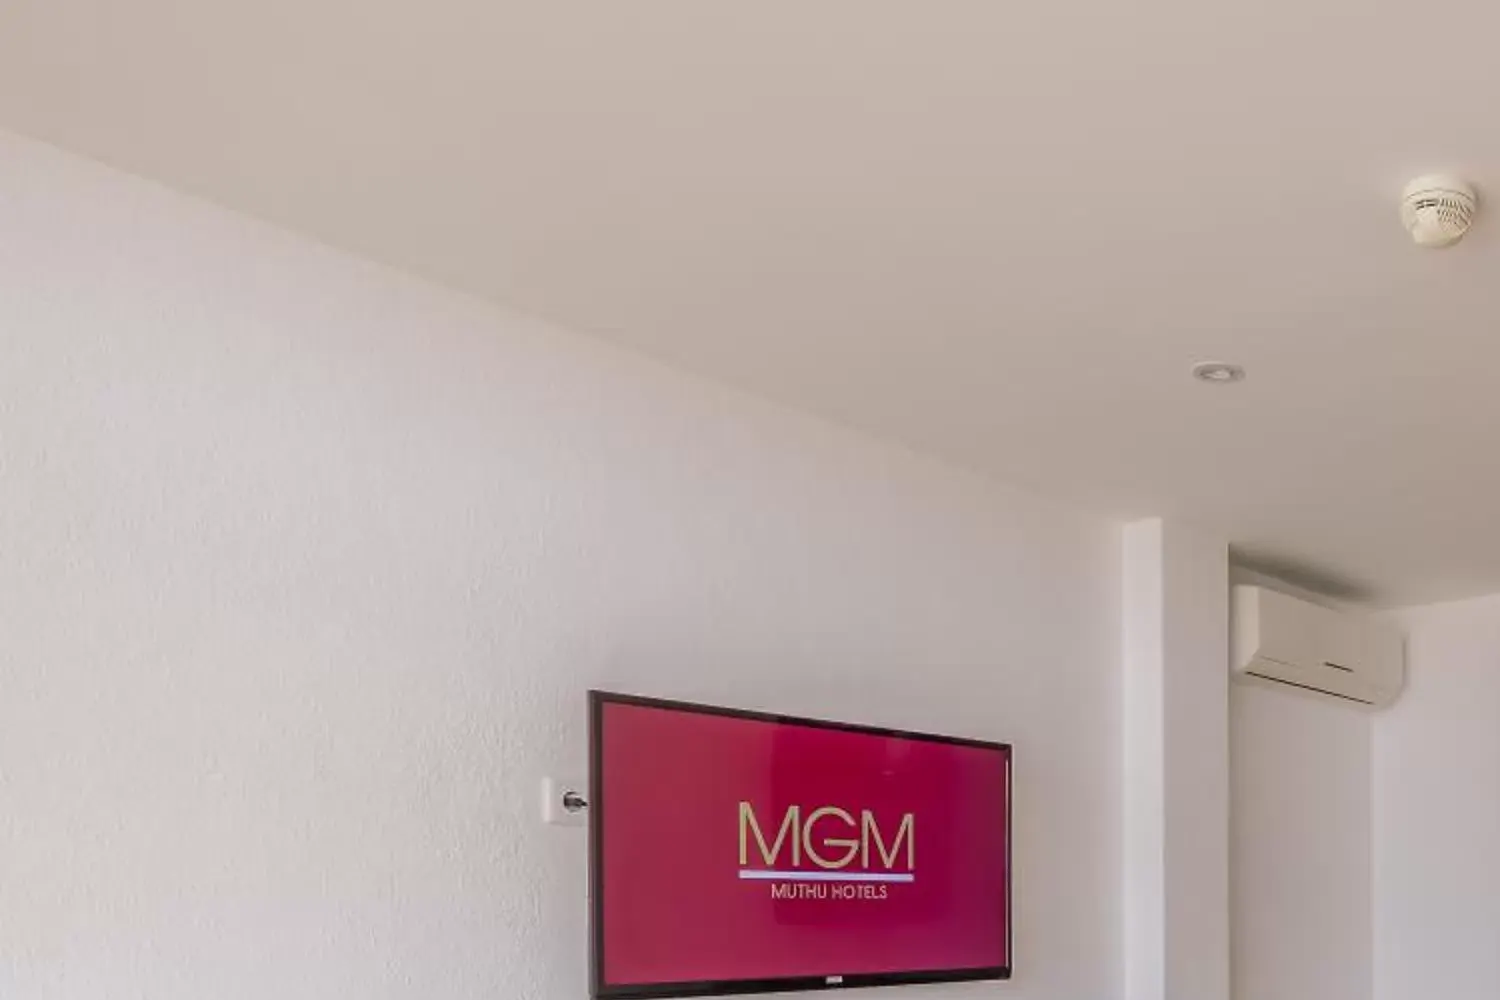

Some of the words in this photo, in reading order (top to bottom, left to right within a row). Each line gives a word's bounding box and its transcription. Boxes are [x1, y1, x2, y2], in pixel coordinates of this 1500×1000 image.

[739, 801, 914, 870] MGM
[771, 883, 827, 899] MUTHU
[831, 885, 887, 899] HOTELS
